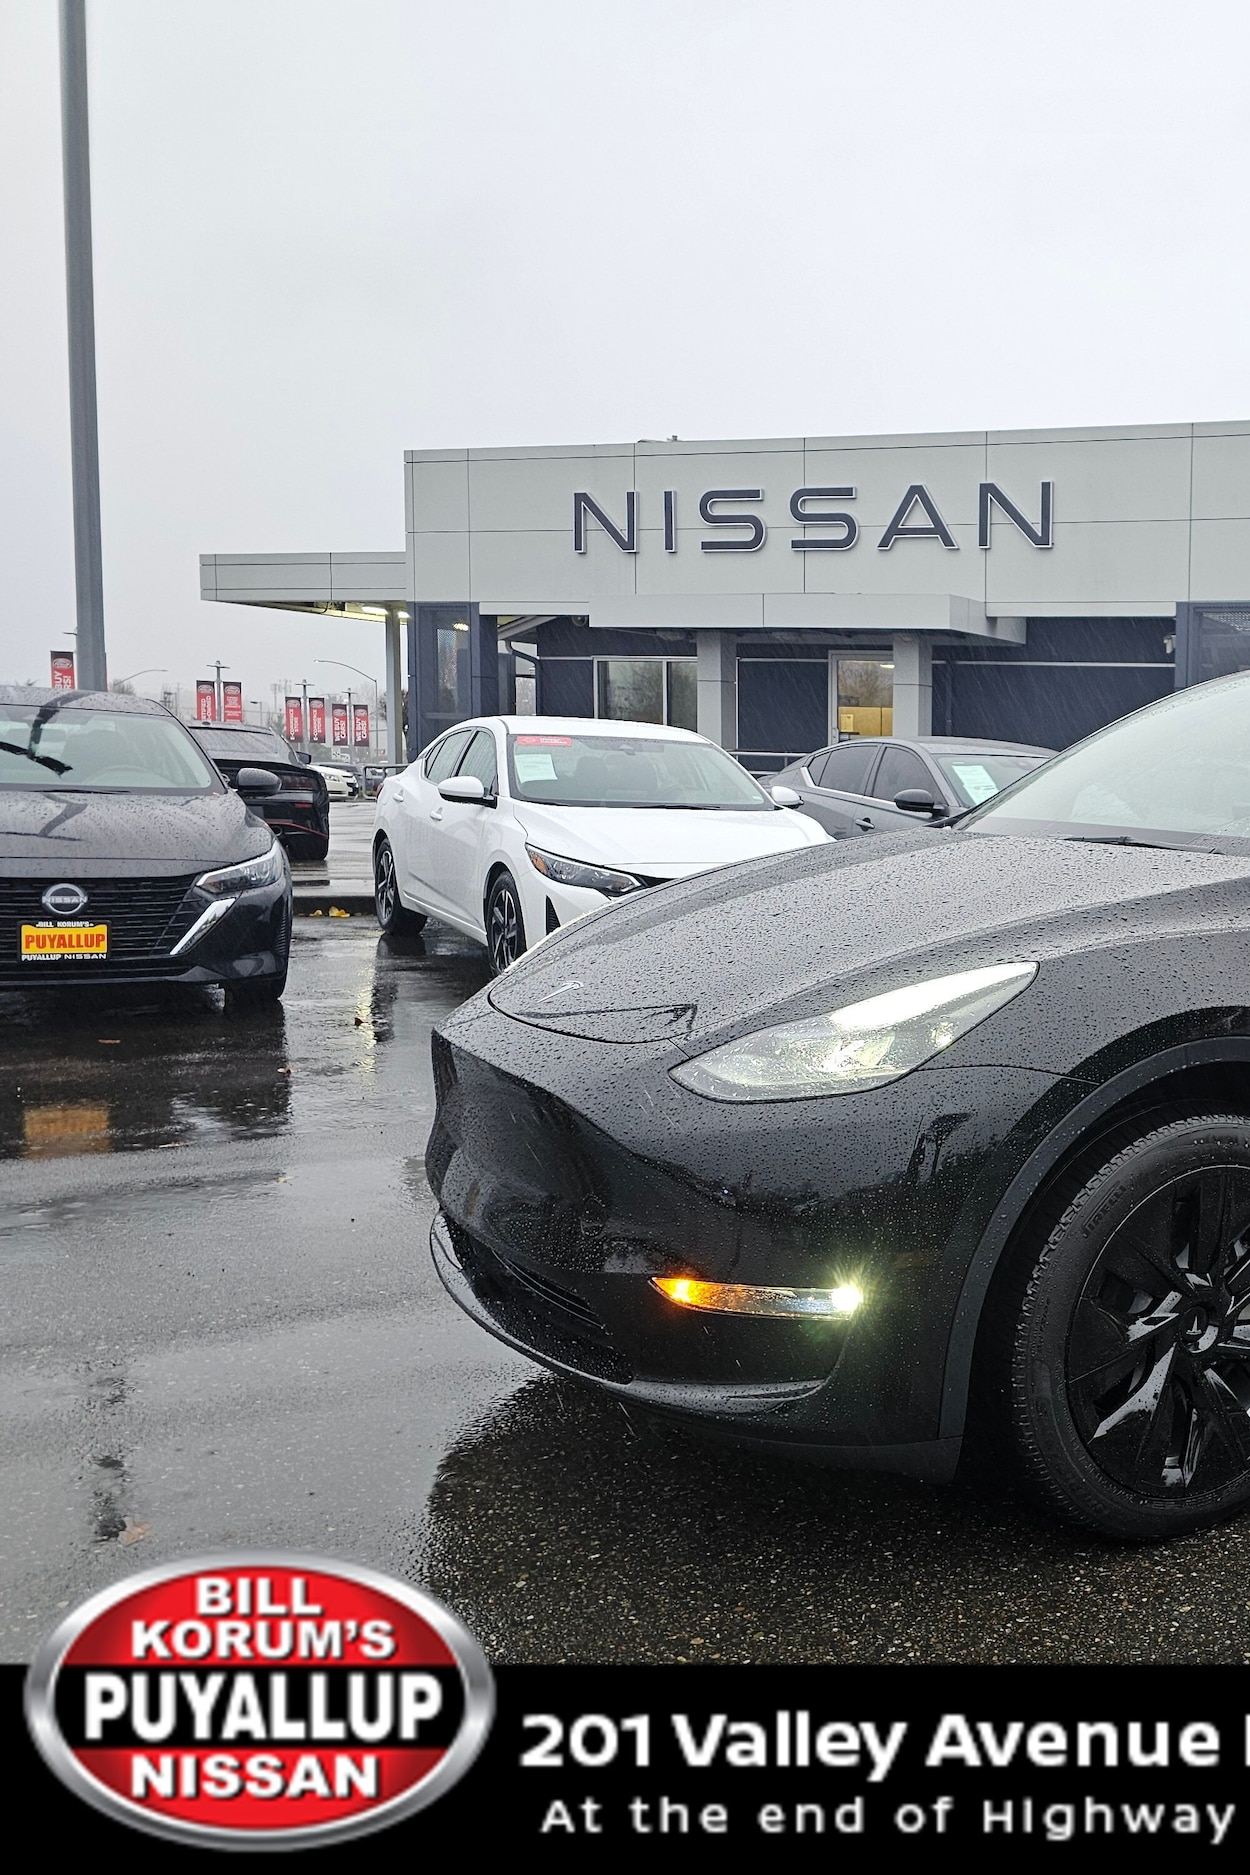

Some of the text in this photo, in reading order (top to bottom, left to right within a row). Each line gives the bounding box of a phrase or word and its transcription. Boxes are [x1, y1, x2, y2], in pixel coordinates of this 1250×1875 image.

[573, 480, 1055, 553] NISSAN
[333, 717, 341, 731] BUY
[41, 896, 88, 904] NISSAN
[25, 933, 106, 949] PUYALLUP
